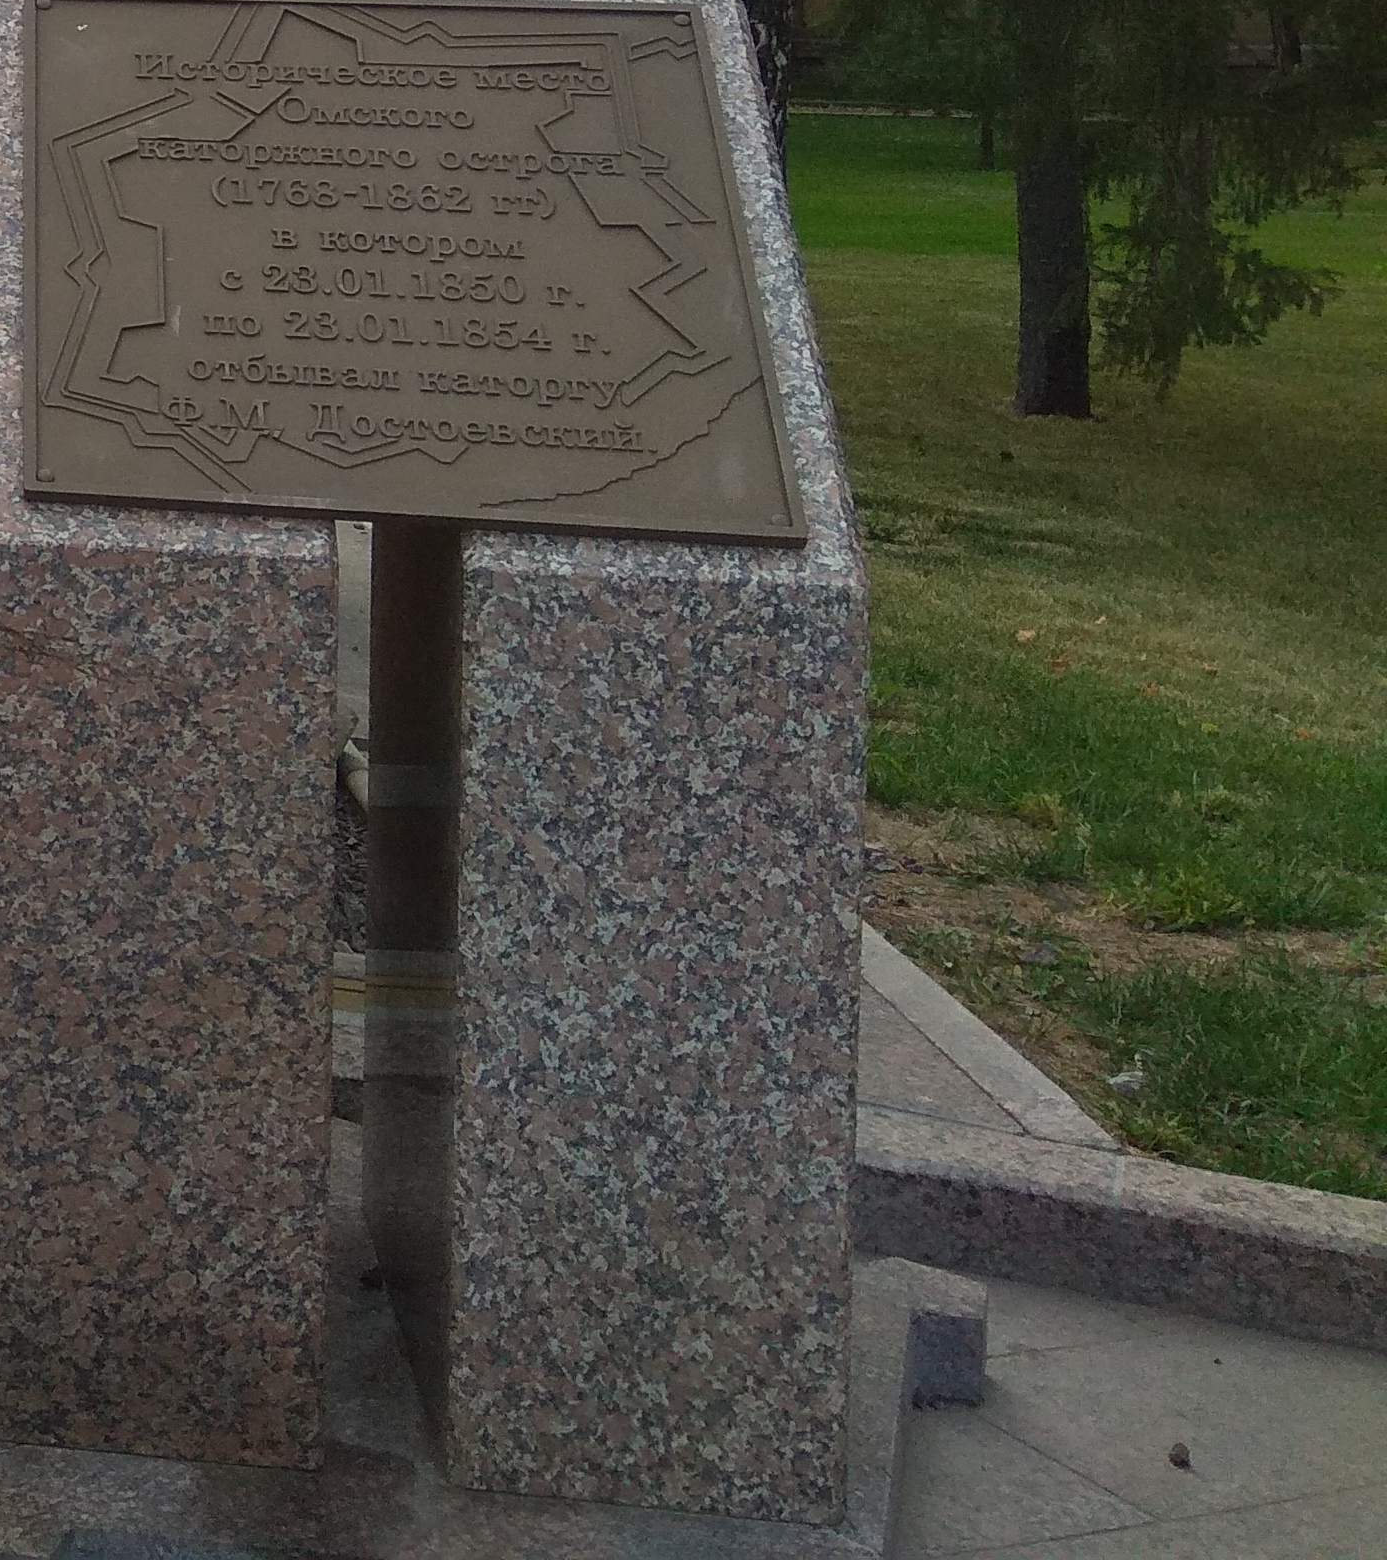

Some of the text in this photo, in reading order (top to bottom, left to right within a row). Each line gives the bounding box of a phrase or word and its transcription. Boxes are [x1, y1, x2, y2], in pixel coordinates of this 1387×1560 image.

[134, 50, 613, 91] Историческое место
[276, 94, 476, 129] Омского
[137, 138, 626, 180] каторжного острога
[211, 174, 474, 214] (1768-1862
[271, 226, 526, 263] в котором
[219, 263, 587, 308] с 23.01.1850 г.
[203, 310, 613, 355] по 23.01.1854 г.
[186, 352, 628, 410] отбывал каторгу
